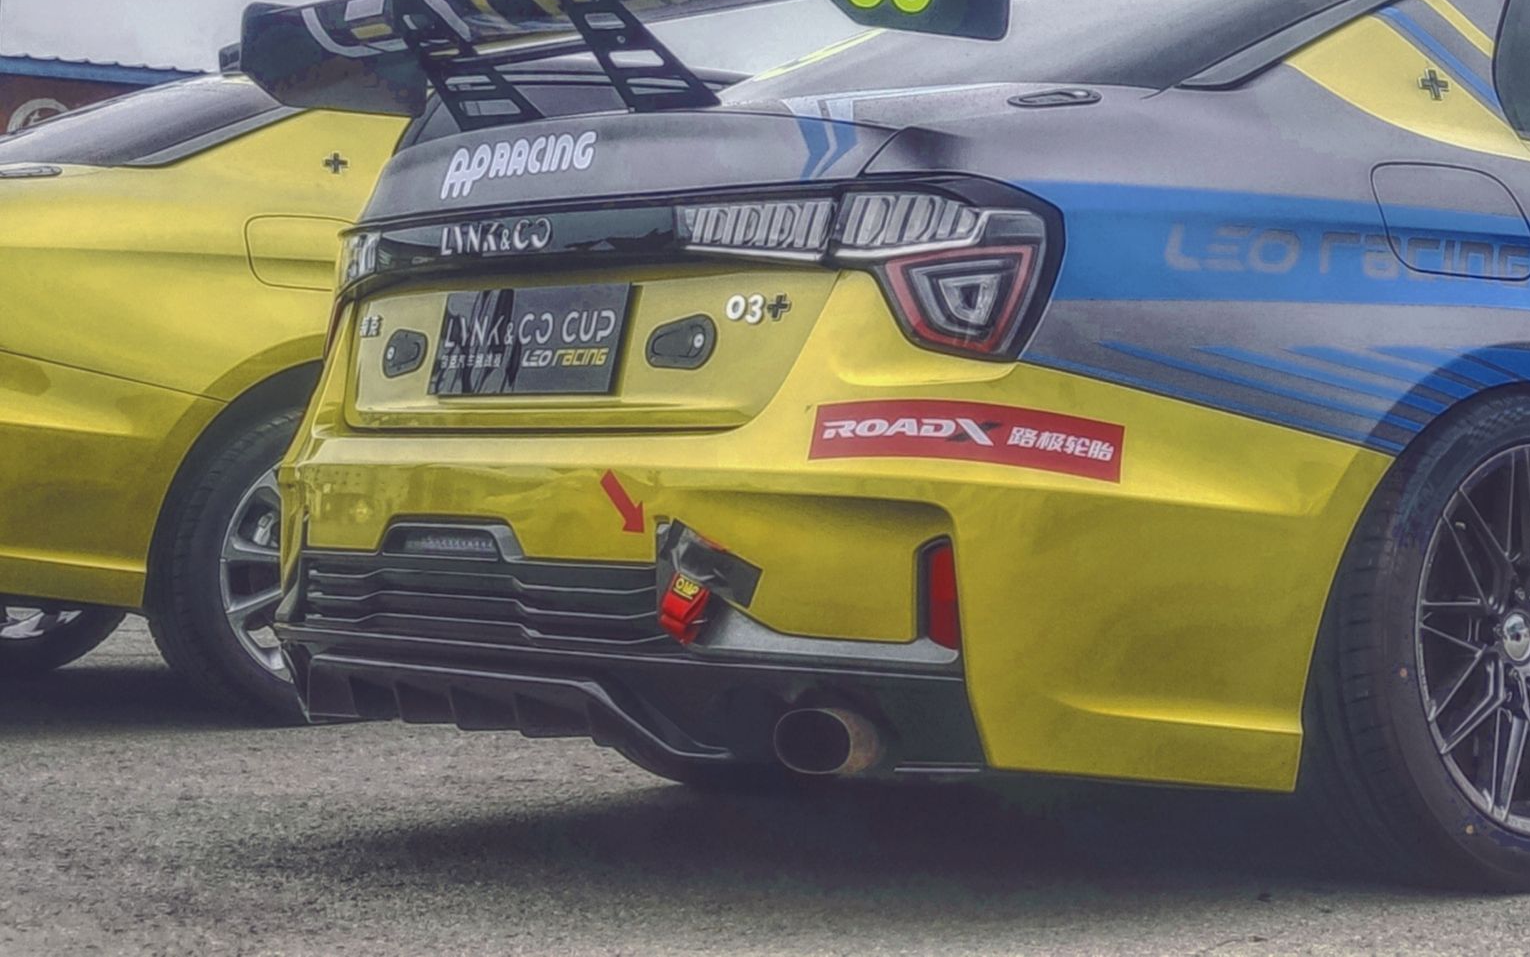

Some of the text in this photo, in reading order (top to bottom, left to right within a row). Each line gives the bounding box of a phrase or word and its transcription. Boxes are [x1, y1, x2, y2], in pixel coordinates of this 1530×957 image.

[1164, 221, 1301, 274] LEO
[562, 309, 617, 344] CUP
[521, 349, 551, 367] LEO
[822, 418, 1003, 447] ROADX
[1006, 426, 1115, 462] 路极轮胎
